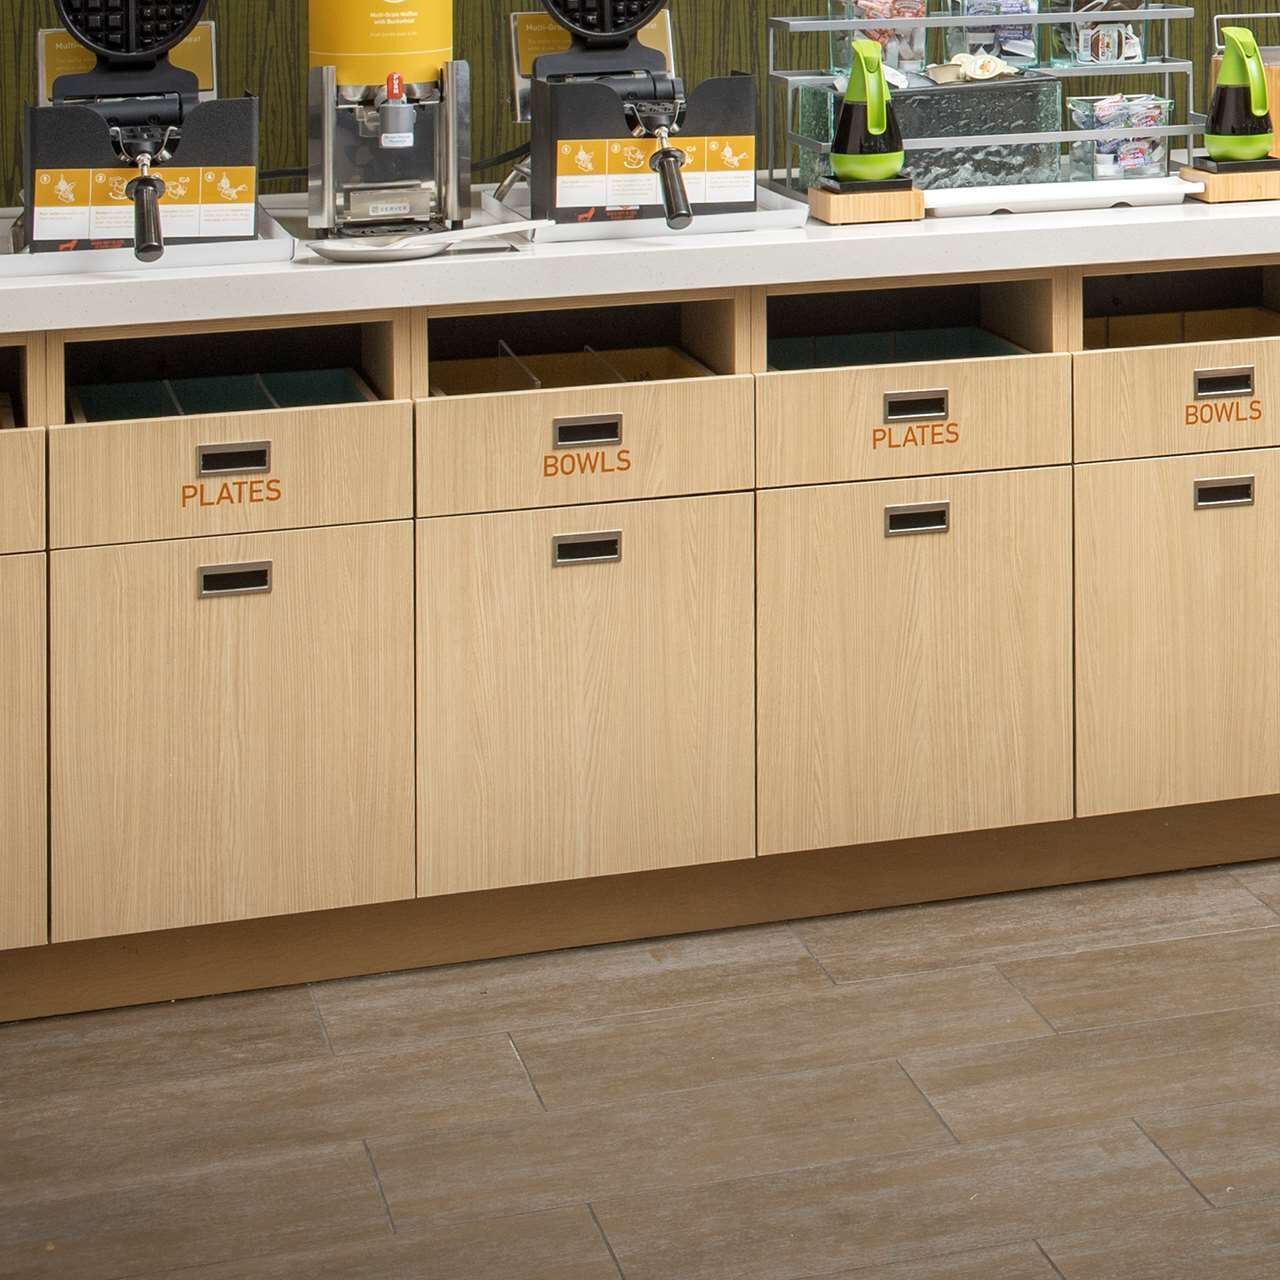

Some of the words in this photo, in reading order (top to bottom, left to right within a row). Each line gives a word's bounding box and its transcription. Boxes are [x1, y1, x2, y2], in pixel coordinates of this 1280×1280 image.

[1184, 400, 1262, 425] BOWLS
[872, 423, 959, 449] PLATES
[543, 450, 631, 477] BOWLS
[181, 479, 282, 507] PLATES
